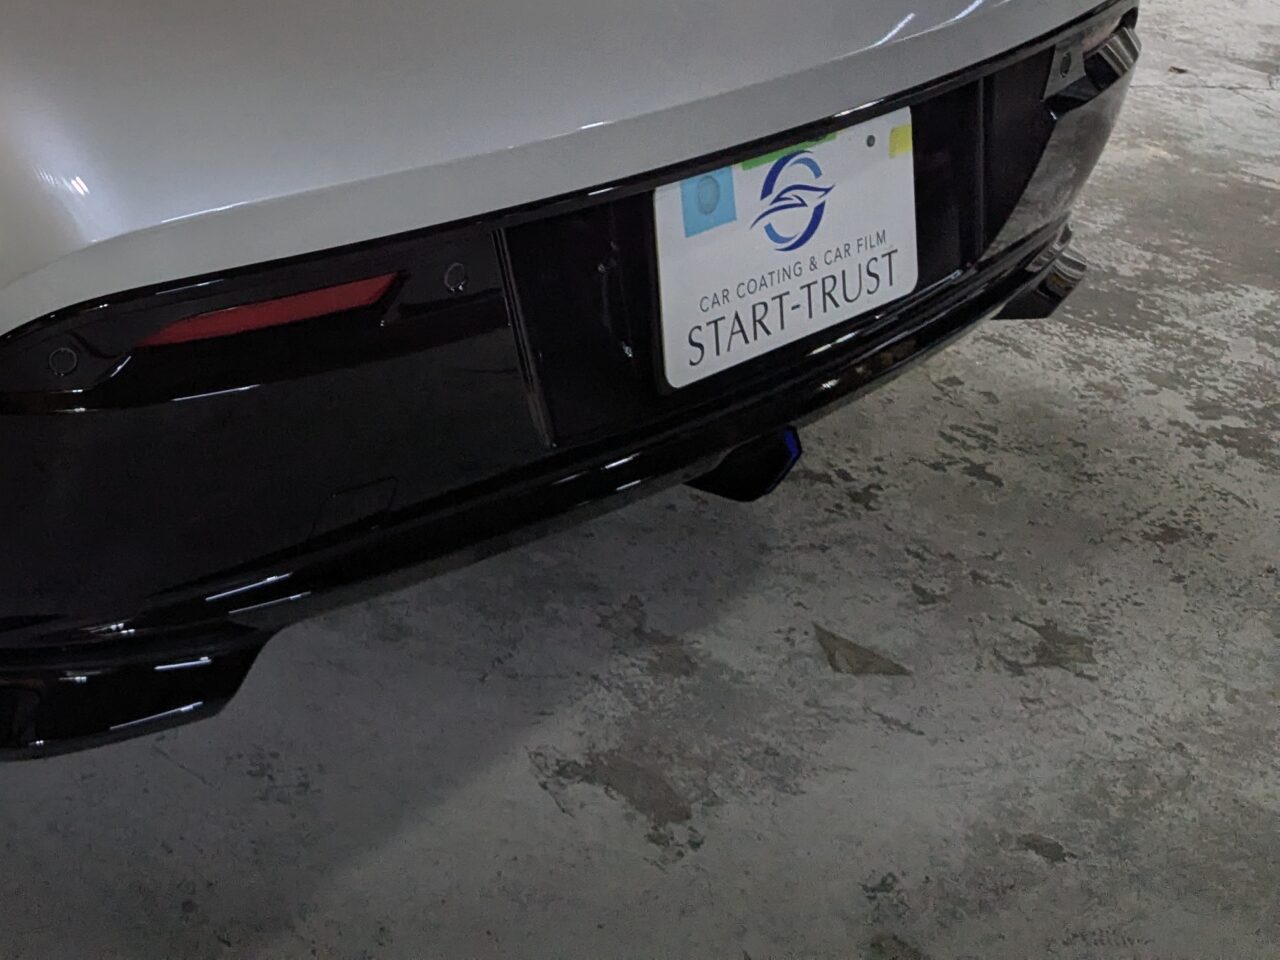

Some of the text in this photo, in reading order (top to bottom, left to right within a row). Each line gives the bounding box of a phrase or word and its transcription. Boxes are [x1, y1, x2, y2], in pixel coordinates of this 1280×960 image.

[687, 248, 899, 367] START-TRUST
[699, 228, 887, 313] CAR COATING & CAR FILM
